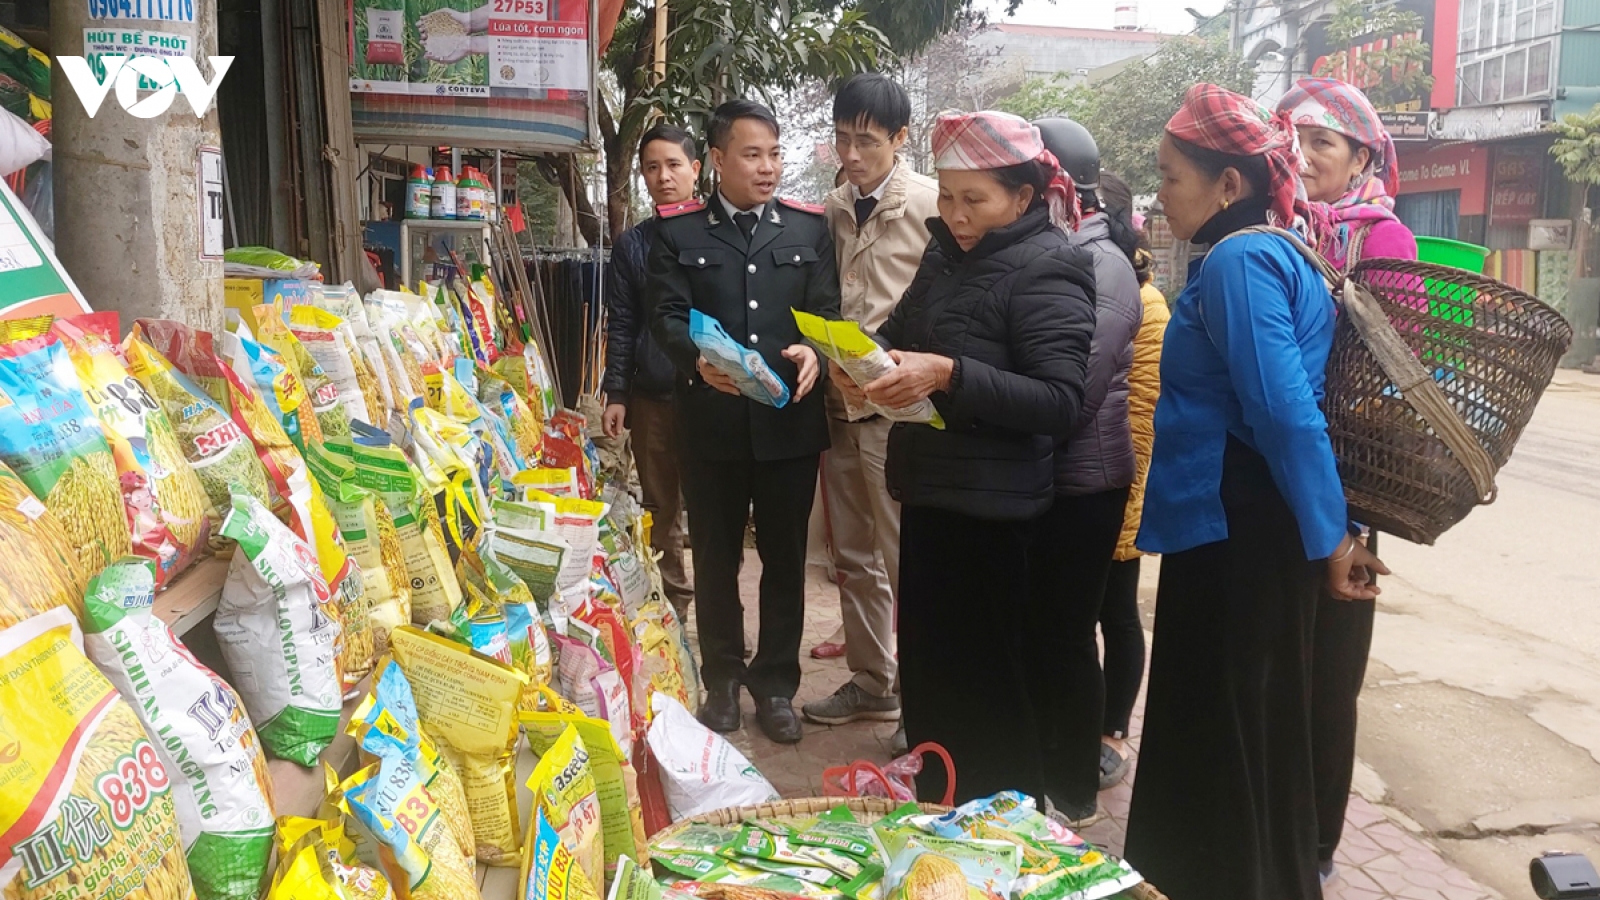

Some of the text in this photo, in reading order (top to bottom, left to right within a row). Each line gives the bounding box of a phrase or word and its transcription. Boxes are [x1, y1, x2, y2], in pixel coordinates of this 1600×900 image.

[494, 0, 544, 14] 27P53
[494, 22, 584, 35] Lúa tốt, cơm ngon
[87, 30, 116, 43] HÚT
[1420, 164, 1429, 179] To
[1431, 163, 1456, 179] Game
[278, 607, 304, 697] LONGPING
[109, 629, 163, 723] SICHUAN
[103, 745, 169, 823] 838
[158, 724, 219, 820] LONGPING
